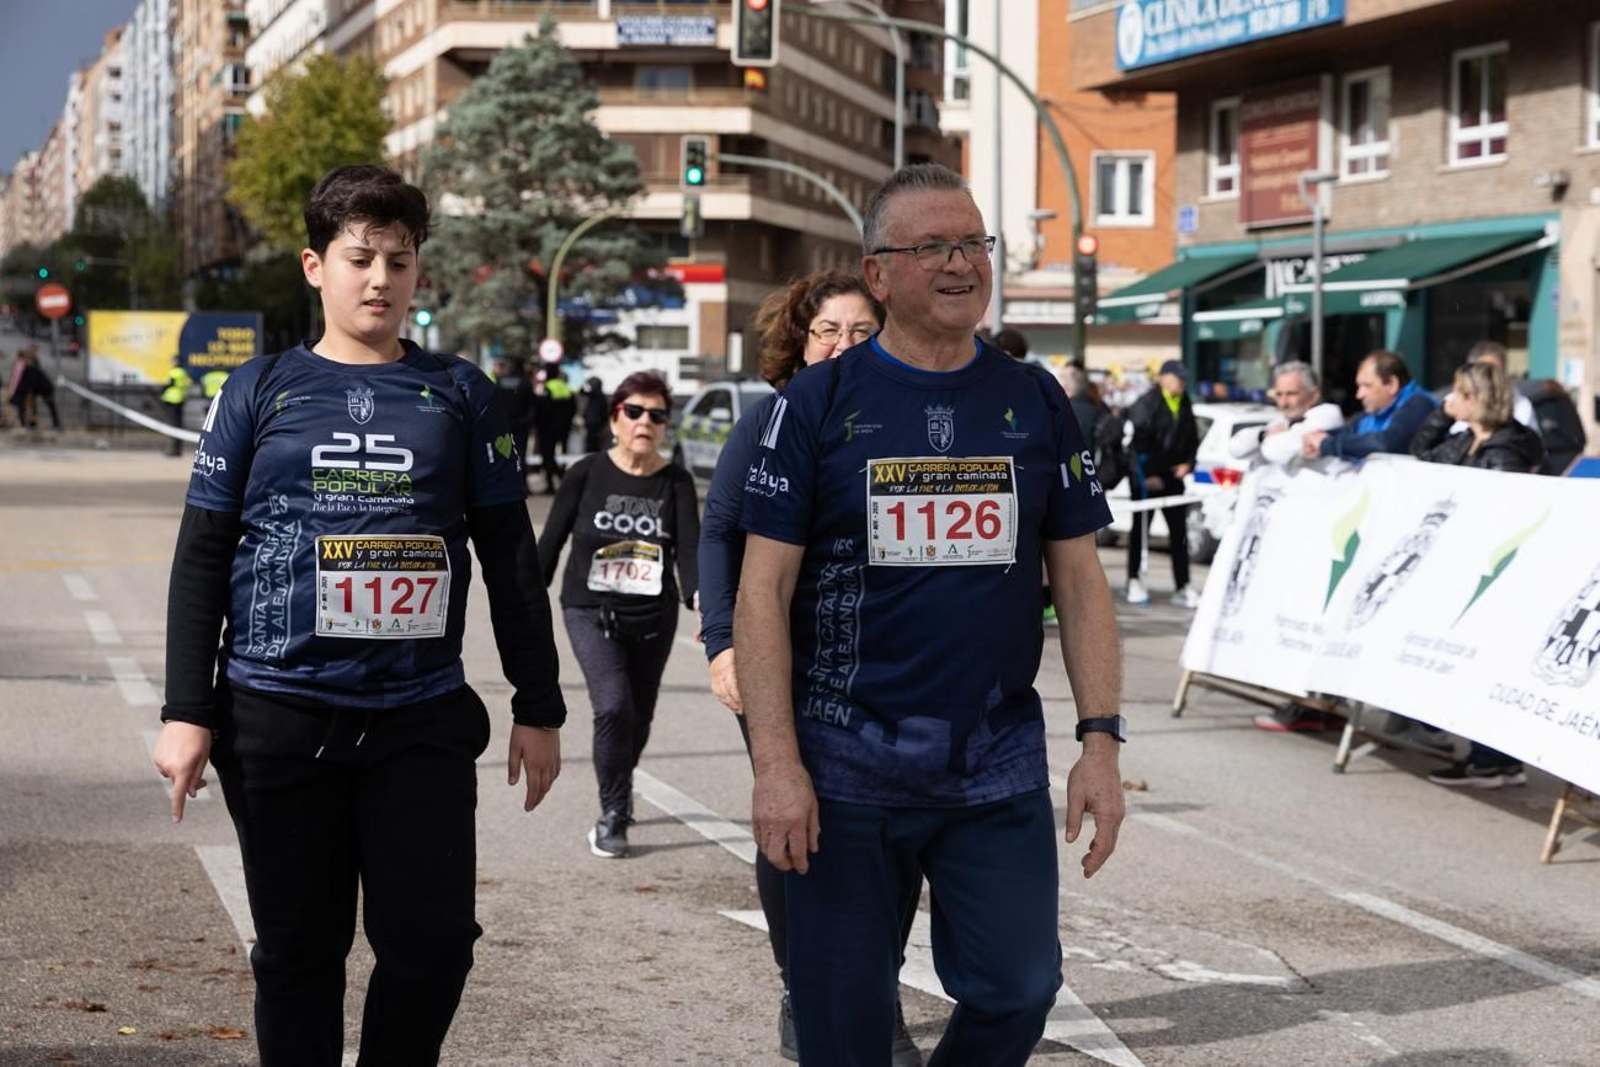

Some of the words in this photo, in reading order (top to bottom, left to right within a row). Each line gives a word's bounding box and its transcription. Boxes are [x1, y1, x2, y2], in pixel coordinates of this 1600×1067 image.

[311, 431, 414, 472] 25
[312, 469, 412, 483] CARRERA
[874, 464, 906, 483] XXV
[908, 463, 957, 473] CARRERA
[959, 463, 1007, 472] POPULAR
[908, 473, 916, 483] y
[922, 472, 951, 483] gran
[956, 471, 1008, 481] caminata
[313, 481, 412, 496] POPULAR
[314, 493, 322, 502] y
[325, 494, 354, 502] gran
[604, 494, 664, 517] STAY
[594, 511, 671, 538] COOL
[886, 499, 1002, 541] 1126
[323, 541, 354, 559] XXV
[356, 541, 403, 550] CARRERA
[405, 541, 444, 551] POPULAR
[356, 550, 363, 559] y
[369, 550, 397, 559] gran
[402, 549, 444, 558] caminata
[600, 561, 652, 582] 1702
[335, 577, 438, 615] 1127
[252, 602, 268, 654] SANTA
[265, 635, 285, 658] DE
[802, 697, 851, 727] JAÉN
[1534, 698, 1560, 722] DE
